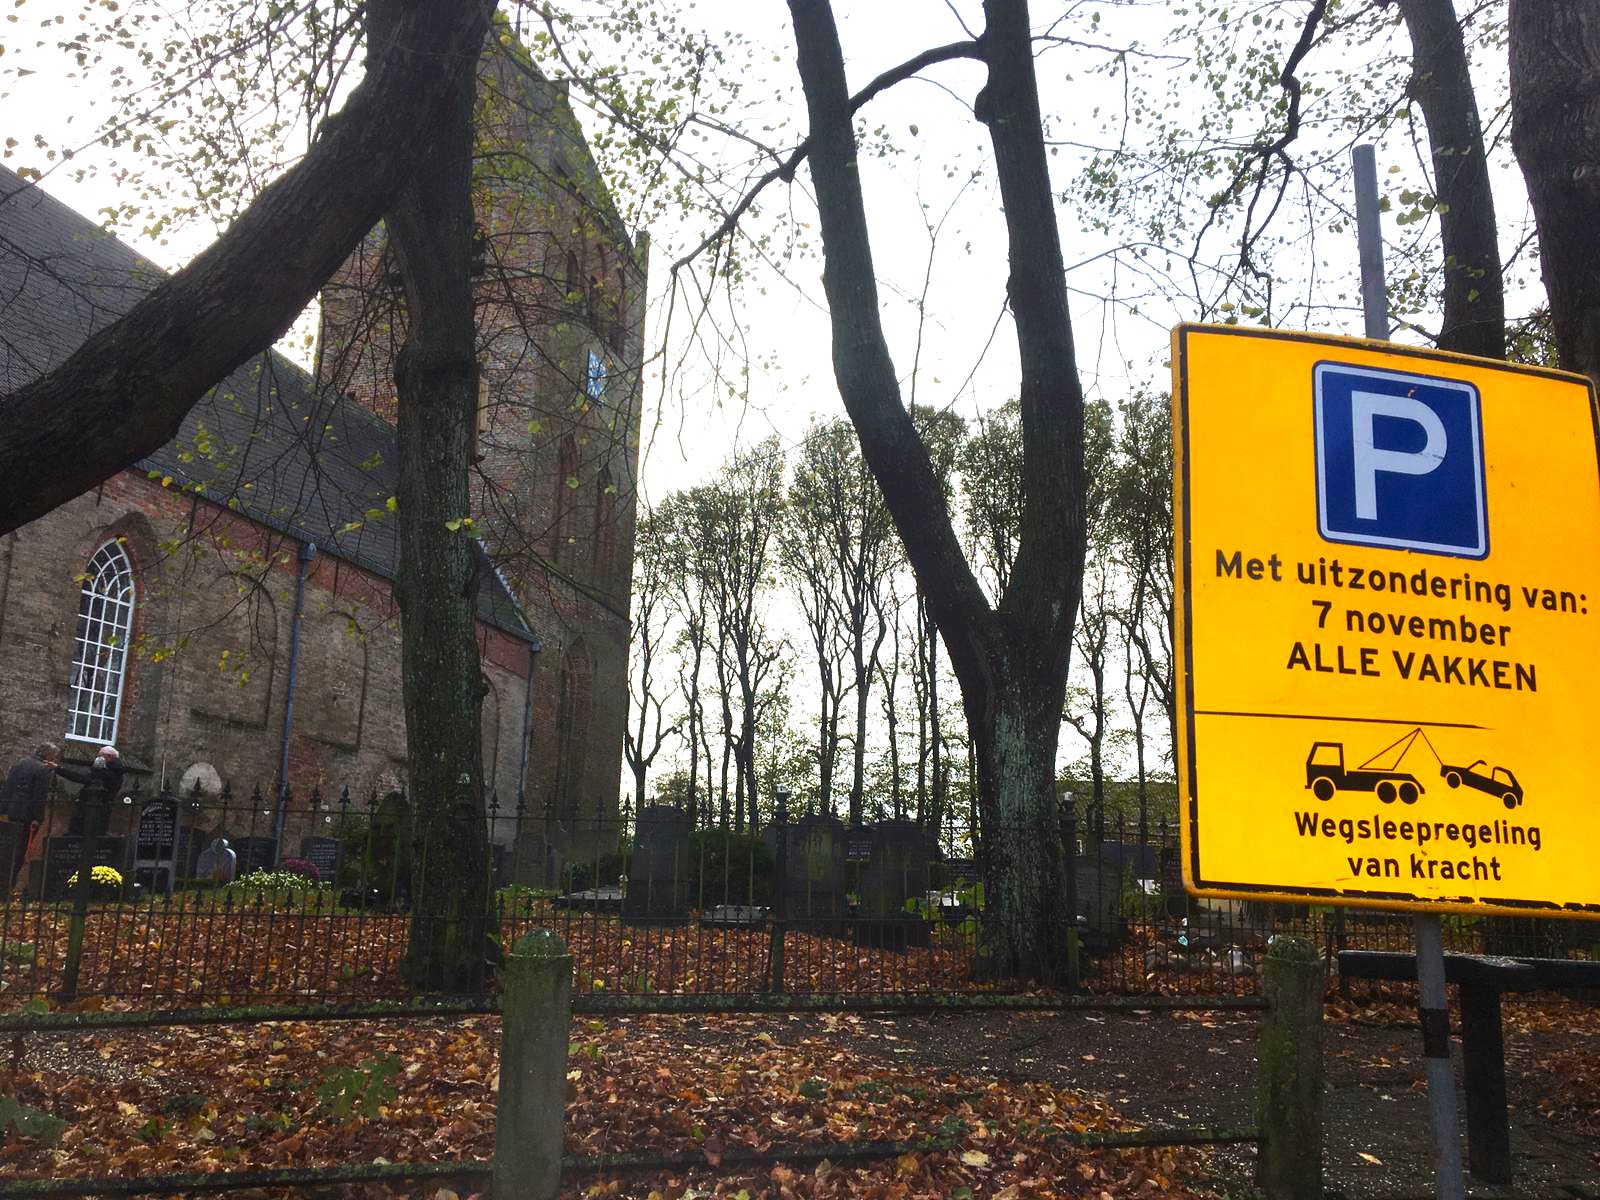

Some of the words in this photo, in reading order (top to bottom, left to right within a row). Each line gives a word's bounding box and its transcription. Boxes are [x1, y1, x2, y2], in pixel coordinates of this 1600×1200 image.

[1351, 390, 1448, 520] P
[1216, 549, 1281, 581] Met
[1298, 557, 1511, 611] uitzondering
[1522, 586, 1588, 615] van:
[1311, 600, 1332, 629] 7
[1346, 609, 1511, 647] november
[1287, 641, 1380, 677] ALLE
[1393, 651, 1537, 692] VAKKEN
[1295, 812, 1541, 850] Wegsleepregeling
[1347, 857, 1400, 878] van
[1411, 854, 1501, 881] kracht
